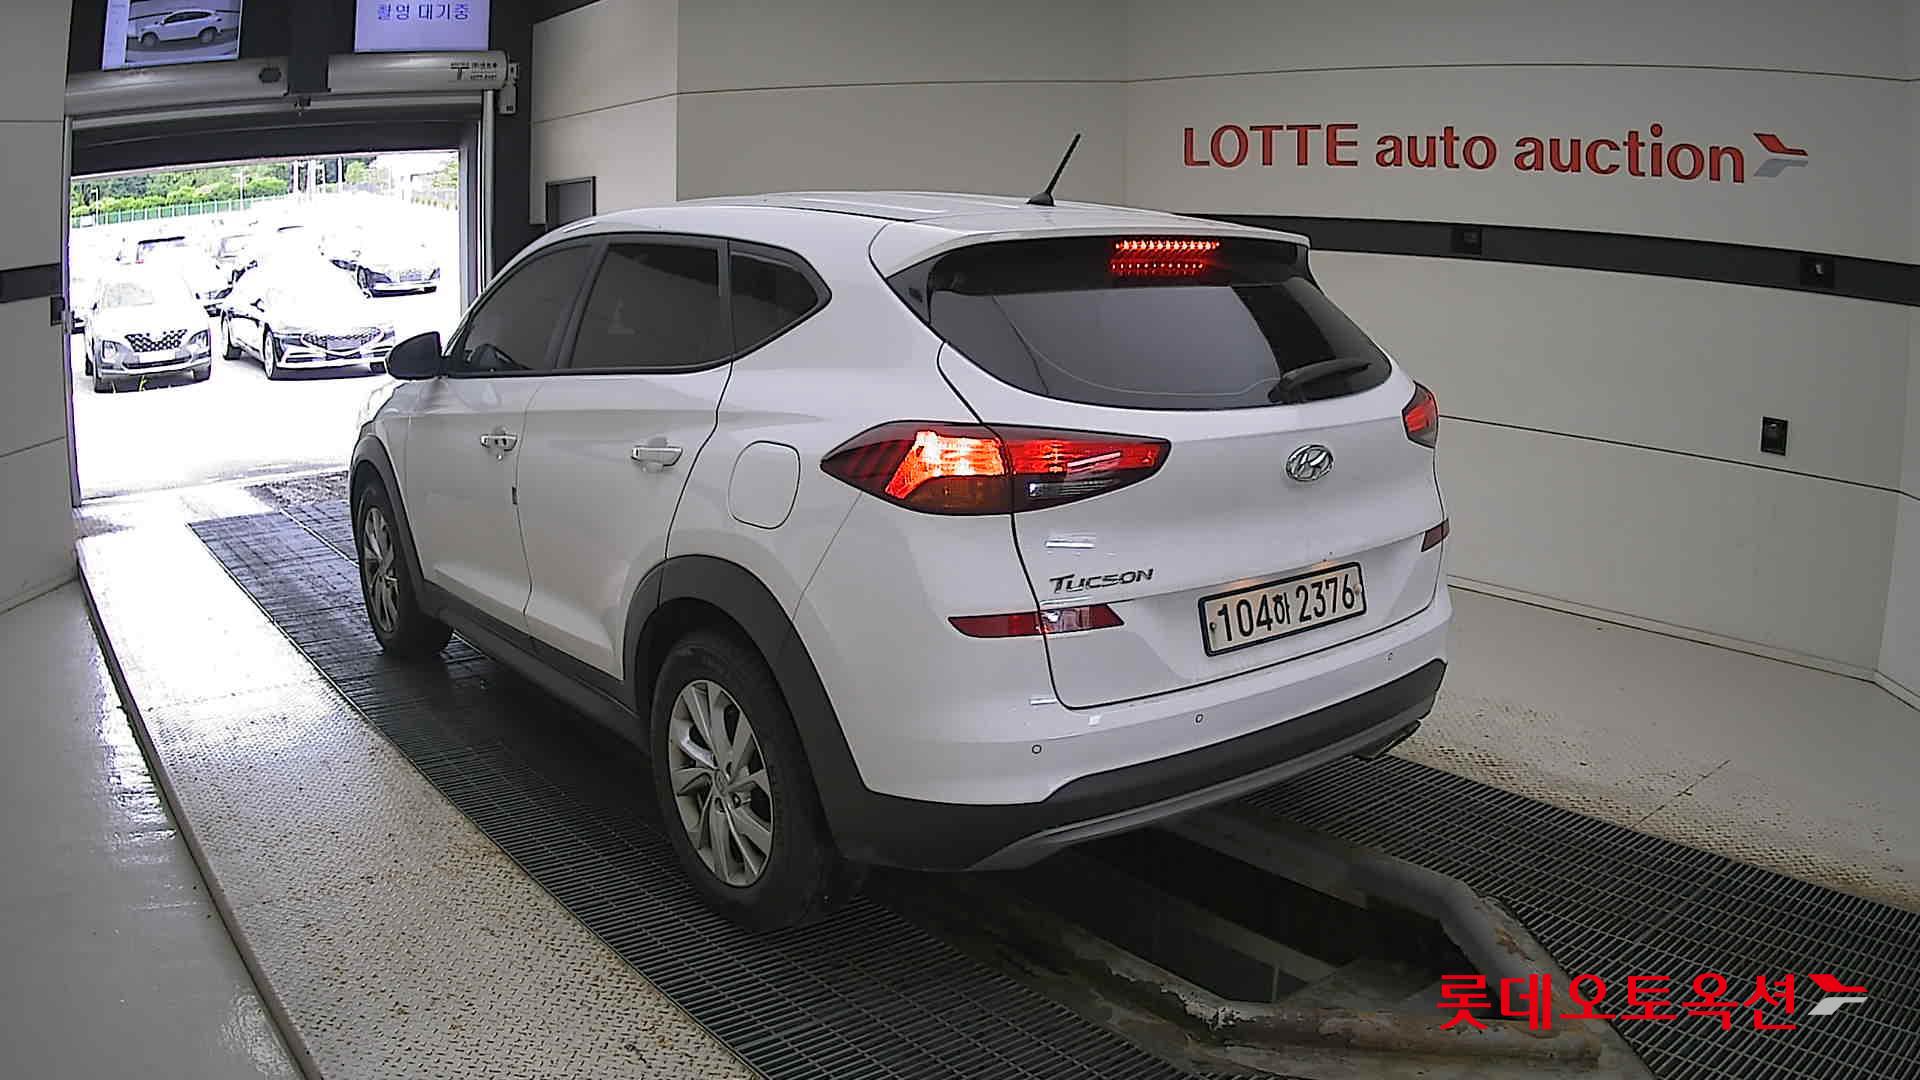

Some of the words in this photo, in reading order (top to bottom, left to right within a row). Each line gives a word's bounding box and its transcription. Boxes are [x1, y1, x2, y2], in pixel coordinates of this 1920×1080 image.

[418, 3, 471, 21] 대기중
[1183, 123, 1359, 169] LOTTE
[1376, 127, 1497, 170] auto
[1514, 123, 1745, 182] auction
[1049, 567, 1154, 594] TUCSON
[1217, 591, 1292, 642] 104하
[1295, 573, 1356, 624] 2376
